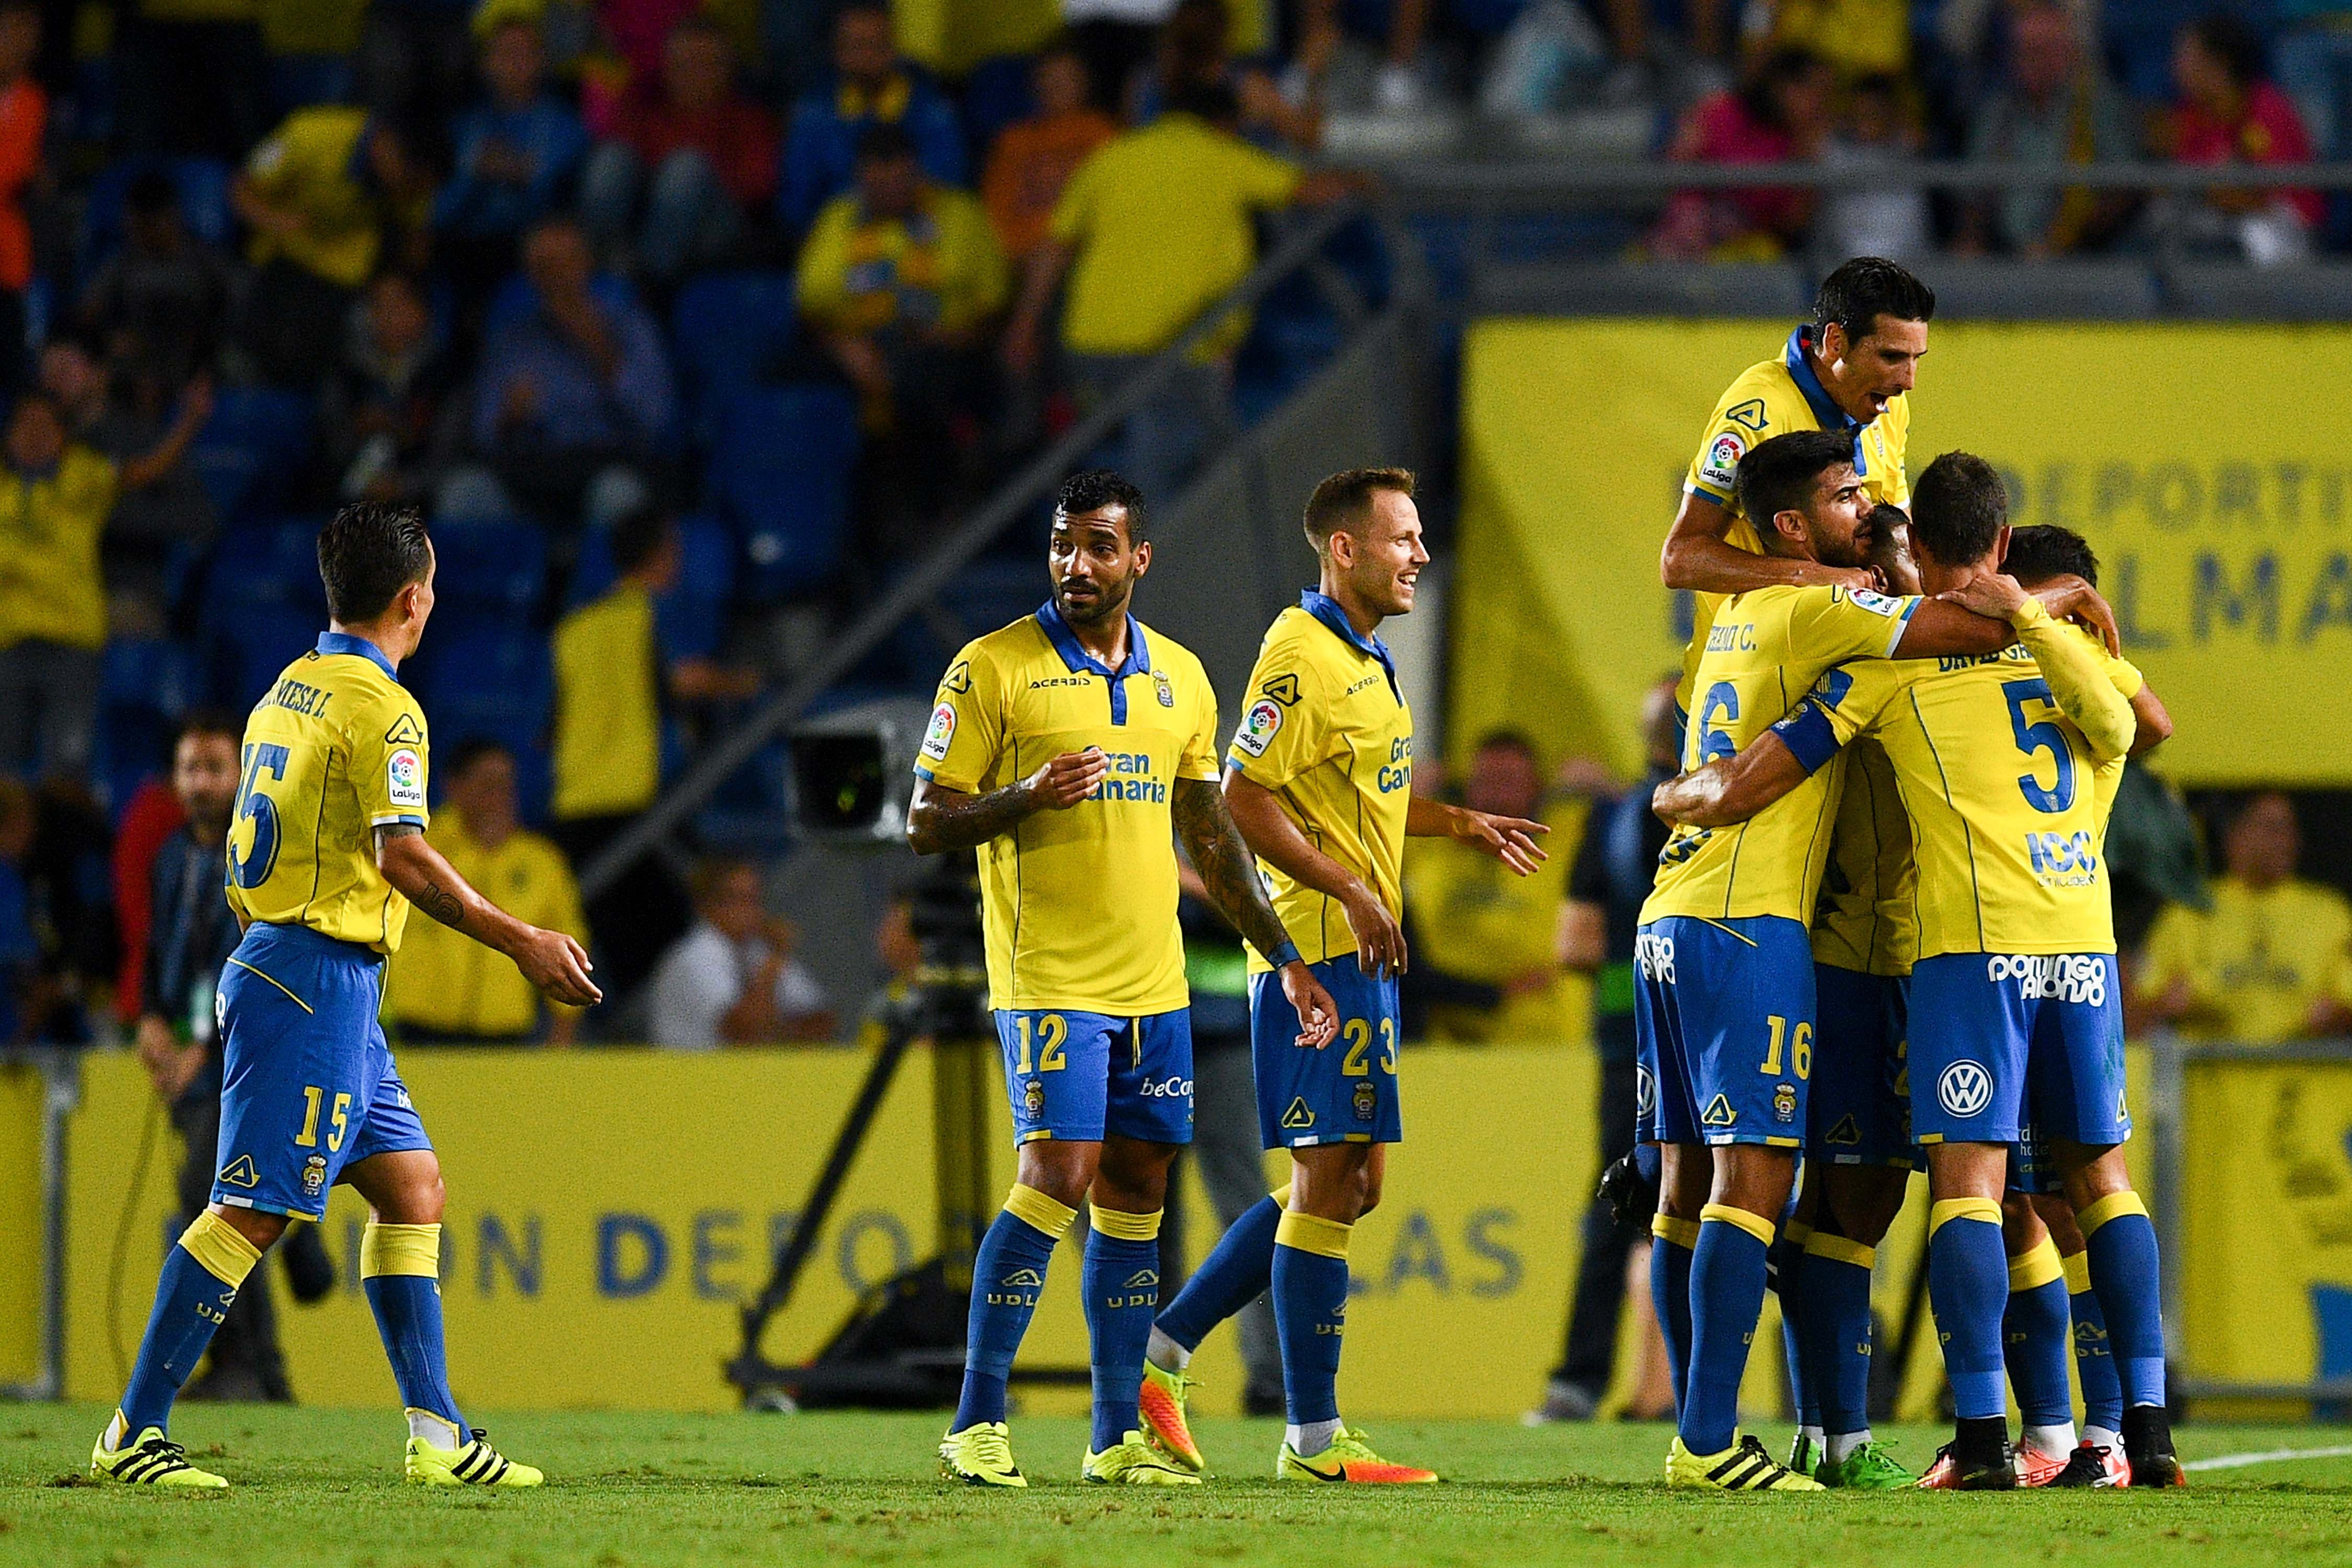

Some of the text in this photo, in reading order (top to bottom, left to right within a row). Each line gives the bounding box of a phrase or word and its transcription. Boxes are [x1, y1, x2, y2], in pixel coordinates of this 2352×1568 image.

[1703, 467, 1732, 483] LaLiga
[1029, 677, 1091, 689] ACERBIS
[1239, 730, 1263, 751] LaLiga
[2000, 678, 2077, 813] 5
[393, 788, 420, 800] LaLiga
[1086, 776, 1166, 804] anaria
[1016, 1014, 1067, 1075] 12
[1342, 1017, 1397, 1076] 23
[1760, 1015, 1813, 1080] 16
[295, 1085, 352, 1152] 15
